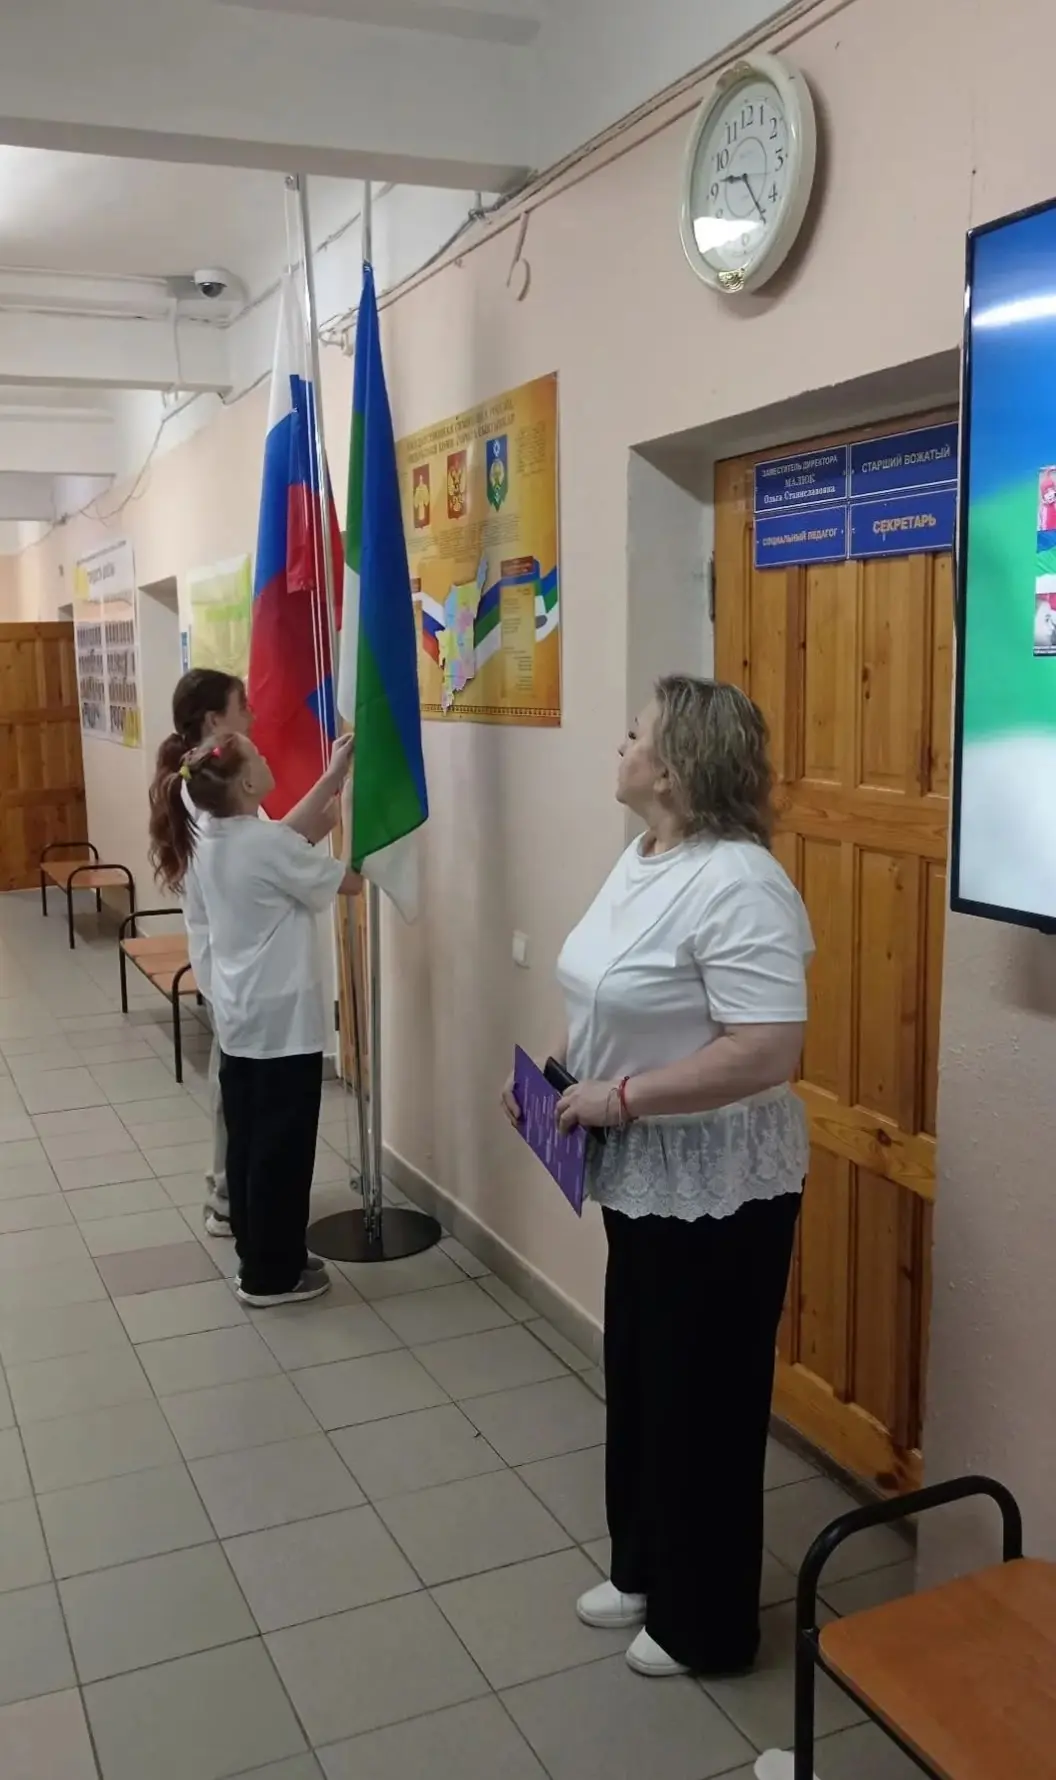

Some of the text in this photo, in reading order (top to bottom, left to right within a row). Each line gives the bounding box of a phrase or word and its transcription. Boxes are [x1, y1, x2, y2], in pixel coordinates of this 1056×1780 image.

[741, 105, 754, 130] 12
[759, 104, 765, 126] 1
[724, 121, 738, 145] 11
[769, 117, 778, 140] 2
[715, 149, 730, 172] 10
[710, 182, 719, 205] 9
[768, 182, 778, 203] 4
[803, 455, 838, 470] ДИРЕКТОРА
[862, 444, 951, 473] СТАРШИЙ ВОЖАТЫЙ
[763, 493, 783, 504] Ольга
[873, 514, 936, 534] СЕКРЕТАРЬ
[762, 527, 838, 547] СОЦИАЛЬНЫЙ ПЕДАГОГ
